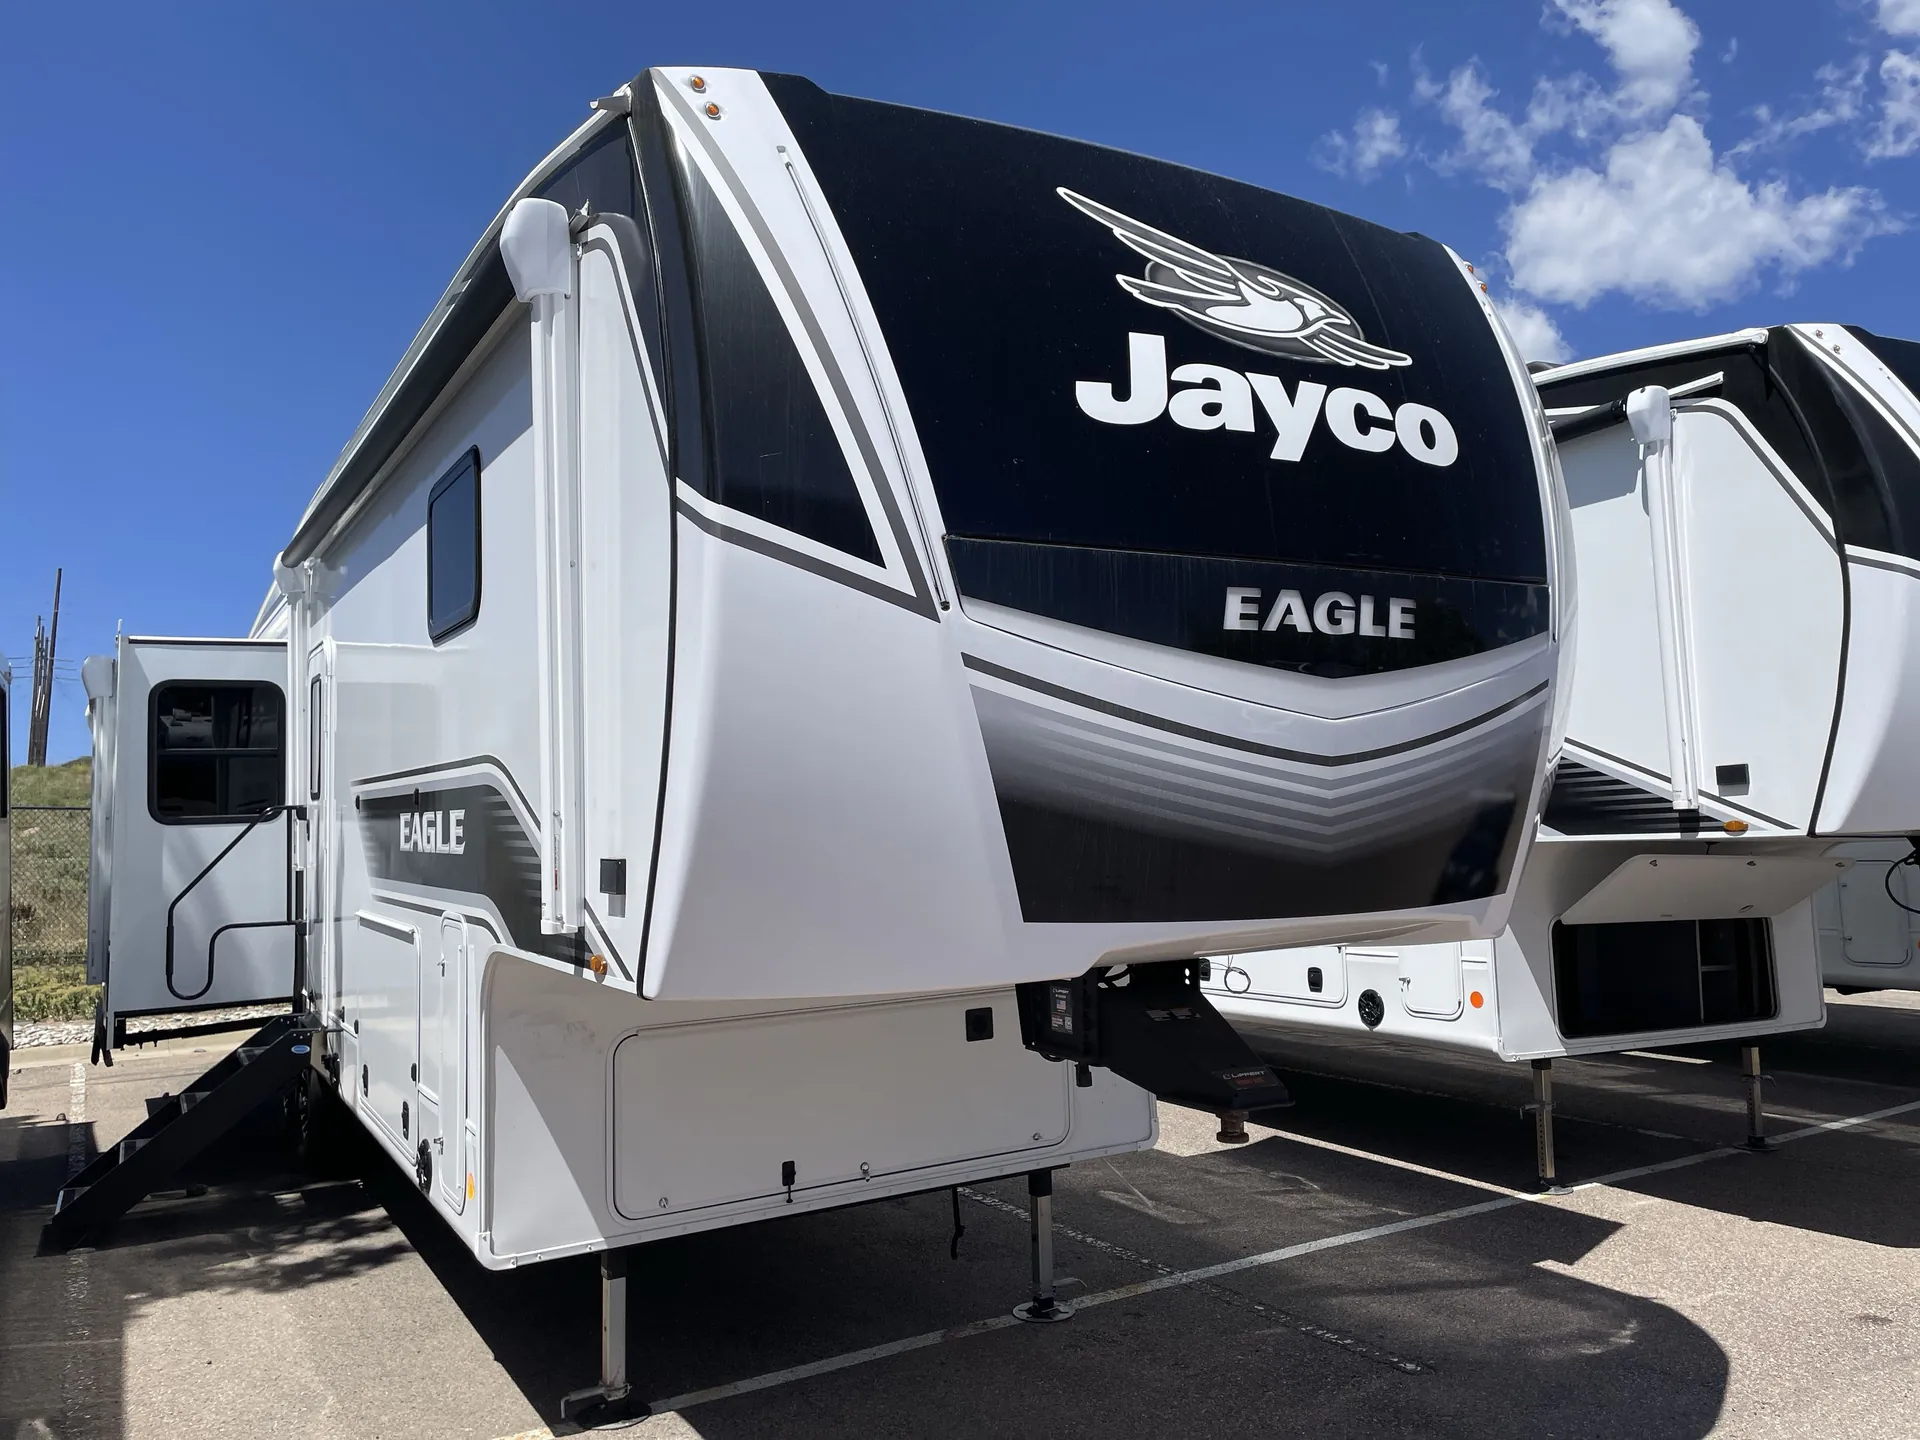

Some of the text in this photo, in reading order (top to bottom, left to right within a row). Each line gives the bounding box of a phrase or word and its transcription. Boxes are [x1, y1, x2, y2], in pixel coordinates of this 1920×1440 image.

[1075, 332, 1459, 467] Jayco
[1223, 587, 1416, 640] EAGLE
[399, 809, 467, 854] EAGLE
